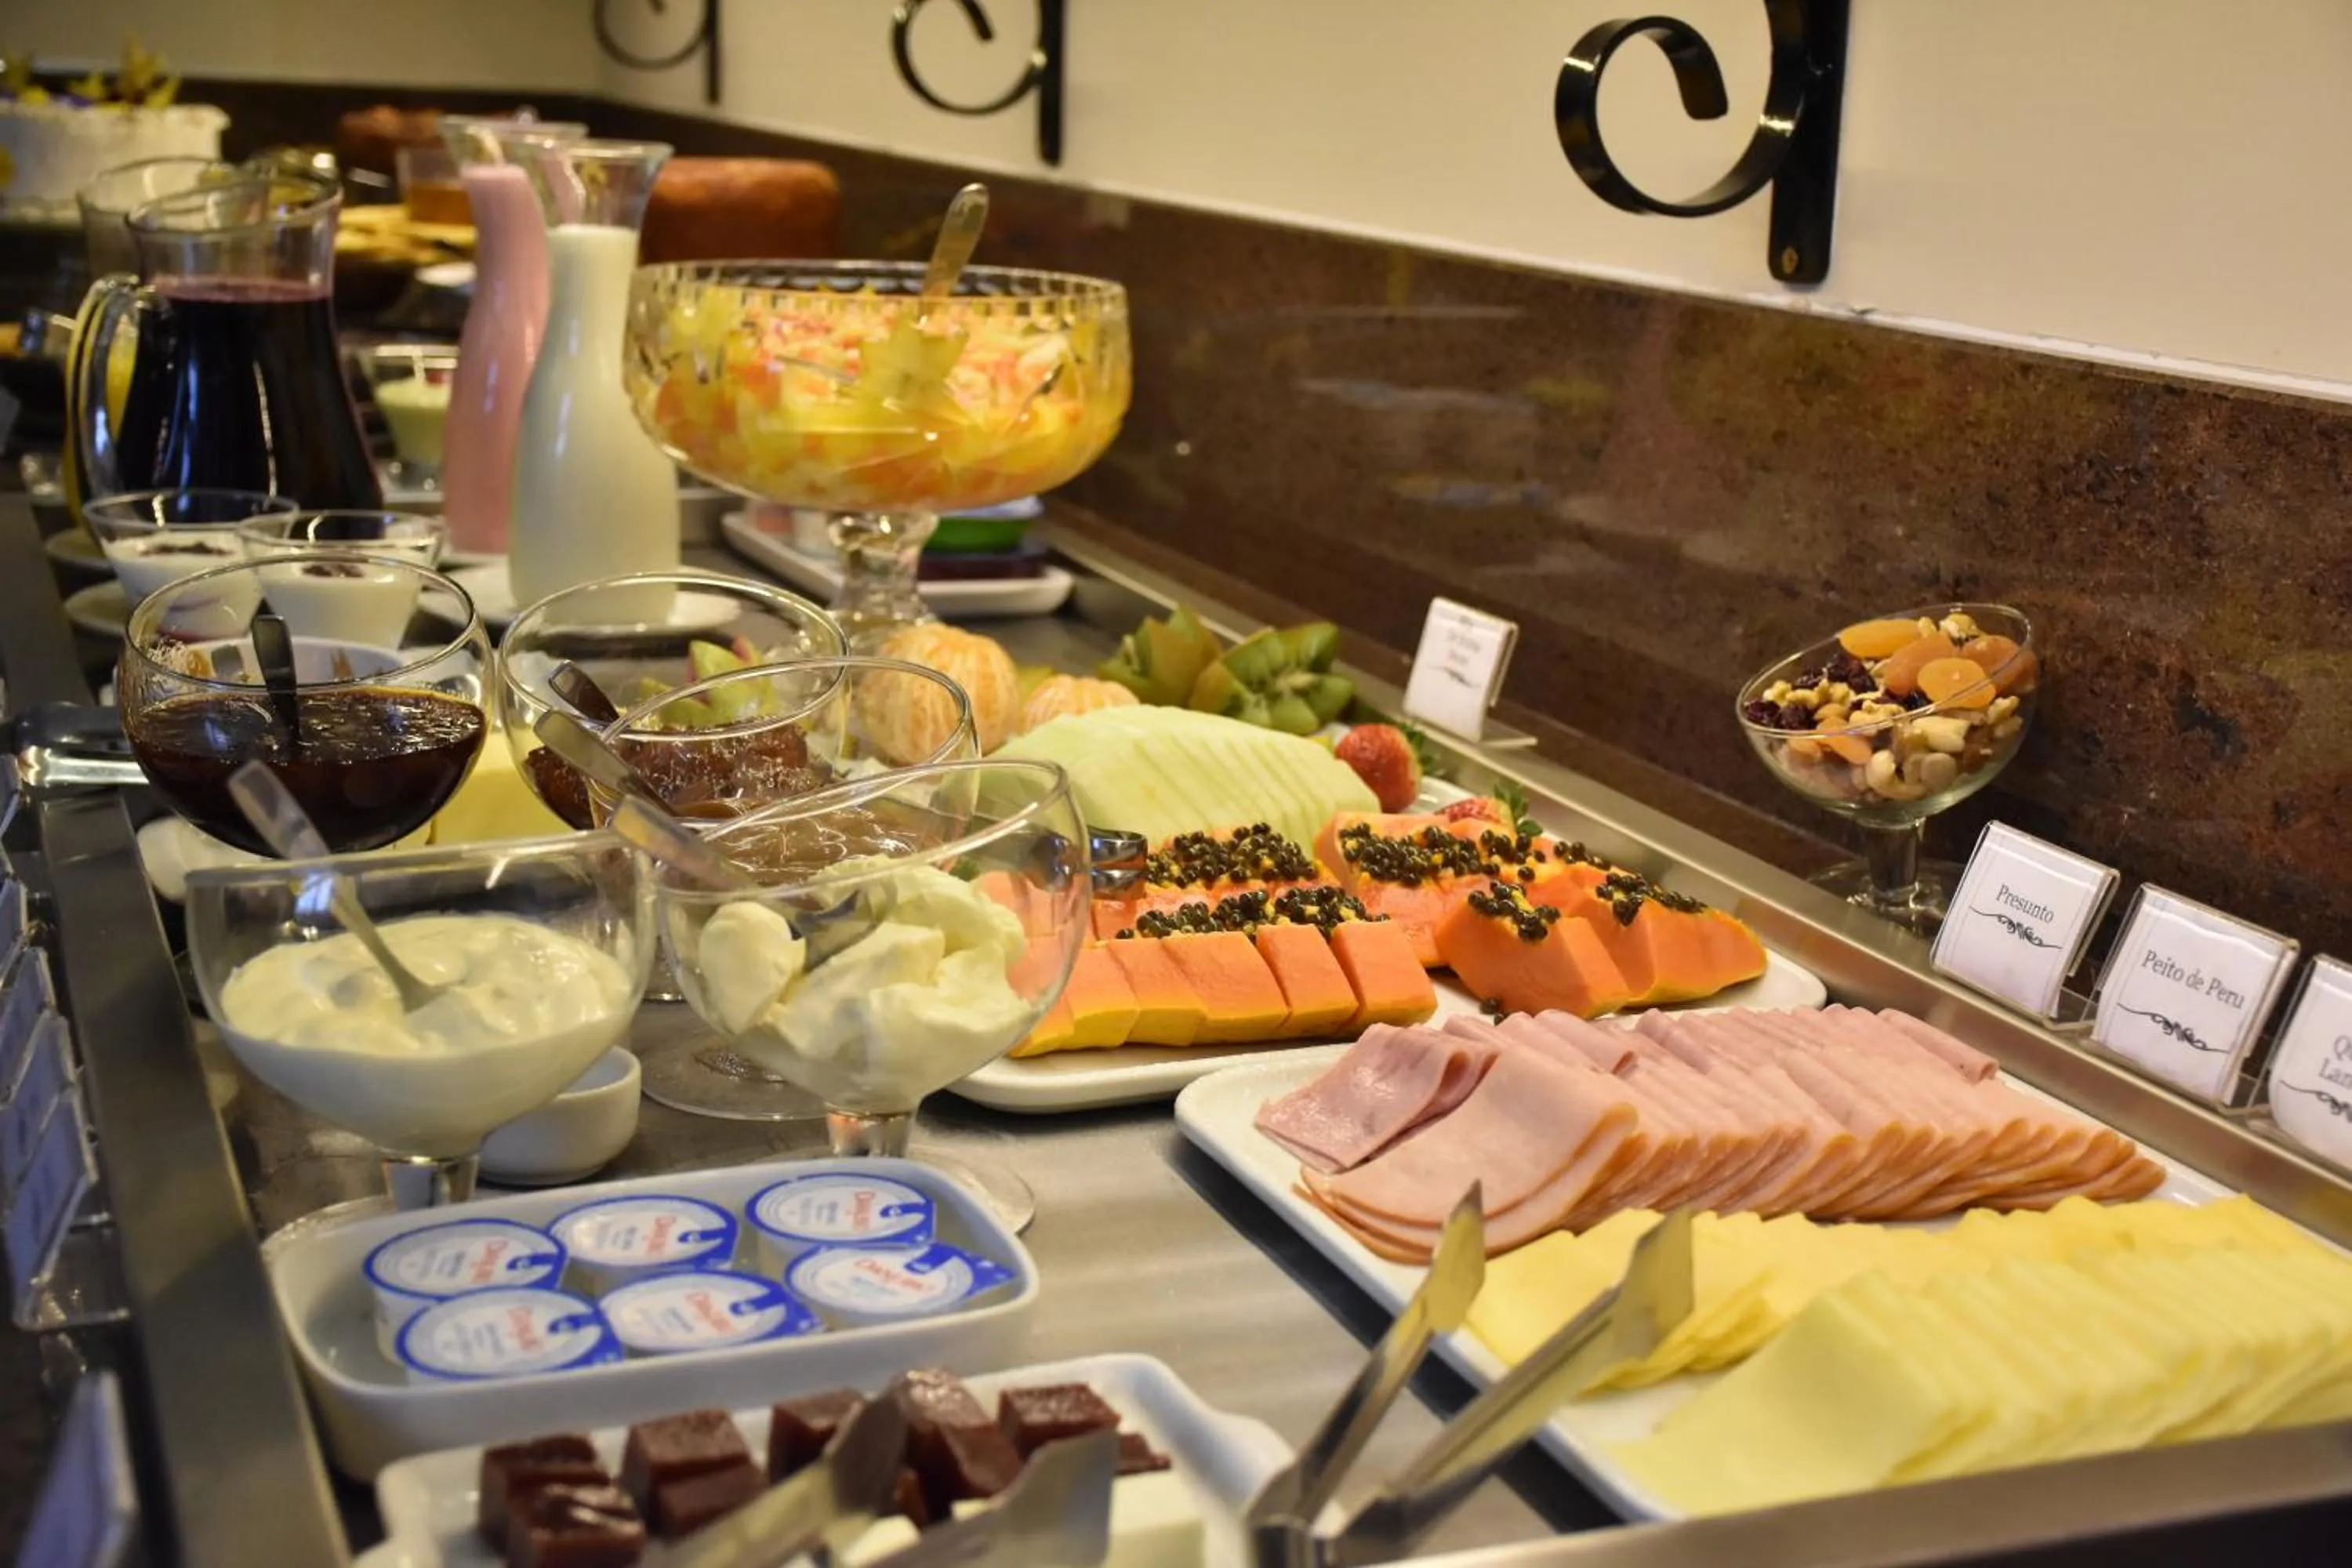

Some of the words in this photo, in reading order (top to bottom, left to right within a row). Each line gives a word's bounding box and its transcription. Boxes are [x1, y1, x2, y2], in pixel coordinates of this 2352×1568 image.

[1996, 884, 2054, 924] Presunto
[2141, 949, 2184, 982] Peito
[2185, 967, 2205, 990] de
[2205, 978, 2245, 1009] Peru
[2333, 1035, 2352, 1062] Q
